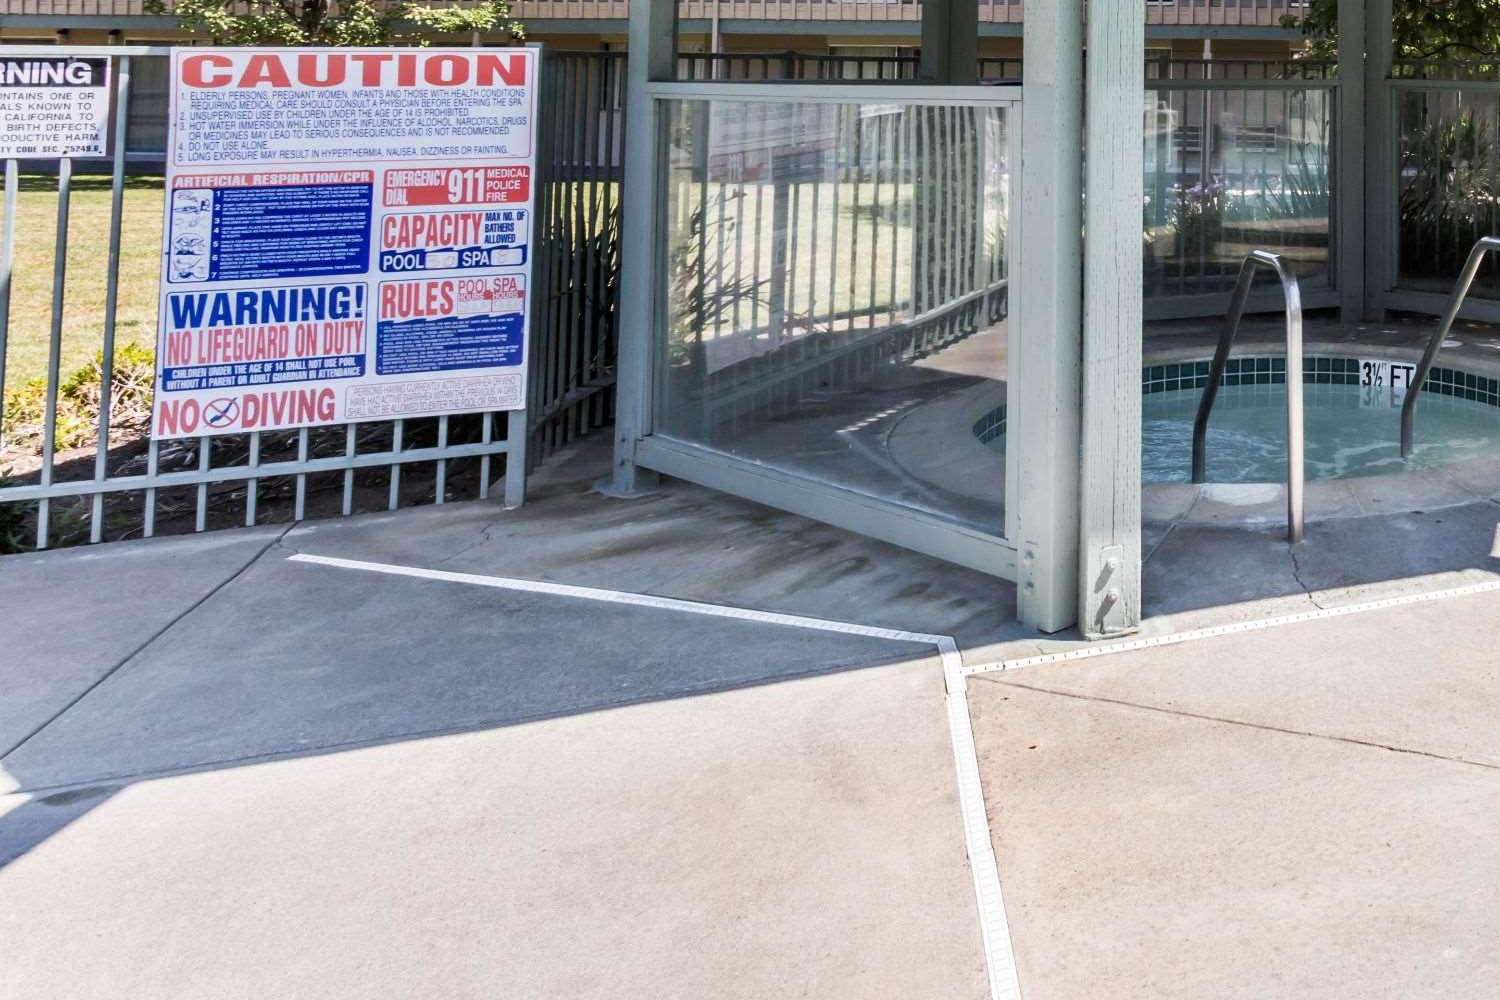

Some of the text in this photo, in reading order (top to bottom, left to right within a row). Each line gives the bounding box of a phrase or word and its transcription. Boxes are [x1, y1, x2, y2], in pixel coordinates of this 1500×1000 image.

[0, 62, 92, 84] NING
[182, 54, 526, 88] CAUTION
[50, 92, 72, 100] ONE
[78, 92, 95, 100] OR
[190, 92, 225, 100] ELDERLY
[272, 90, 315, 100] PREGNANT
[352, 90, 384, 98] INFANTS
[386, 90, 400, 98] AND
[404, 90, 428, 98] THOSE
[430, 89, 448, 98] WITH
[451, 89, 478, 98] HEALTH
[481, 88, 526, 98] CONDITIONS
[191, 101, 236, 110] REQUIRING
[240, 101, 273, 109] MEDICAL
[277, 101, 298, 109] CARE
[300, 100, 333, 108] SHOULD
[335, 100, 370, 108] CONSULT
[380, 99, 419, 108] PHYSICIAN
[422, 99, 452, 107] BEFORE
[454, 98, 490, 107] ENTERING
[493, 98, 506, 106] THE
[190, 111, 253, 120] UNSUPERVISED
[256, 111, 273, 119] USE
[274, 111, 284, 119] BY
[287, 110, 326, 119] CHILDREN
[329, 110, 356, 118] UNDER
[358, 110, 372, 118] THE
[375, 109, 390, 117] AGE
[392, 109, 403, 117] OF
[406, 109, 412, 117] 14
[416, 109, 422, 117] IS
[190, 122, 206, 130] HOT
[208, 122, 236, 130] WATER
[239, 121, 284, 130] IMMERSION
[287, 120, 311, 128] WHILE
[314, 120, 340, 128] UNDER
[343, 120, 358, 128] THE
[360, 119, 404, 127] INFLUENCE
[406, 119, 416, 127] OF
[502, 117, 527, 125] DRUGS
[189, 132, 201, 140] OR
[204, 132, 248, 140] MEDICINES
[251, 131, 268, 139] MAY
[270, 131, 290, 139] LEAD
[294, 130, 303, 138] TO
[305, 130, 339, 138] SERIOUS
[342, 129, 406, 137] CONSEQUENCES
[408, 128, 423, 136] AND
[426, 128, 432, 136] IS
[435, 128, 449, 136] NOT
[188, 142, 200, 151] DO
[203, 142, 220, 150] NOT
[222, 142, 239, 150] USE
[188, 152, 210, 161] LONG
[214, 151, 258, 160] EXPOSURE
[260, 151, 276, 159] MAY
[280, 150, 309, 158] RESULT
[312, 150, 319, 158] IN
[421, 146, 459, 155] DIZZINESS
[461, 146, 472, 154] OR
[176, 171, 369, 188] ARTIFICIAL RESPIRATION/CPR
[387, 169, 448, 187] EMERGENCY
[487, 168, 528, 178] MEDICAL
[448, 169, 485, 203] 911
[486, 180, 520, 190] POLICE
[386, 189, 408, 205] DIAL
[486, 192, 507, 201] FIRE
[485, 212, 500, 221] MAX
[517, 212, 525, 220] OF
[384, 213, 483, 249] CAPACITY
[485, 223, 514, 232] BATHERS
[484, 234, 515, 244] ALLOWED
[383, 252, 424, 270] POOL
[462, 252, 489, 266] SPA
[459, 278, 517, 294] POOL SPA
[170, 286, 364, 329] WARNING!
[382, 281, 454, 319] RULES
[167, 330, 192, 366] NO
[199, 325, 289, 364] LIFEGUARD
[295, 323, 318, 357] ON
[324, 321, 364, 356] DUTY
[172, 357, 356, 379] CHILDREN UNDER THE AGE OF 14 SHALL NOT USE POOL
[168, 367, 361, 390] WITHOUT A PARENT OR ADULT GUARDIAN IN ATTENDANCE
[1391, 365, 1415, 389] FT
[158, 398, 200, 435] NO
[241, 388, 335, 429] DIVING
